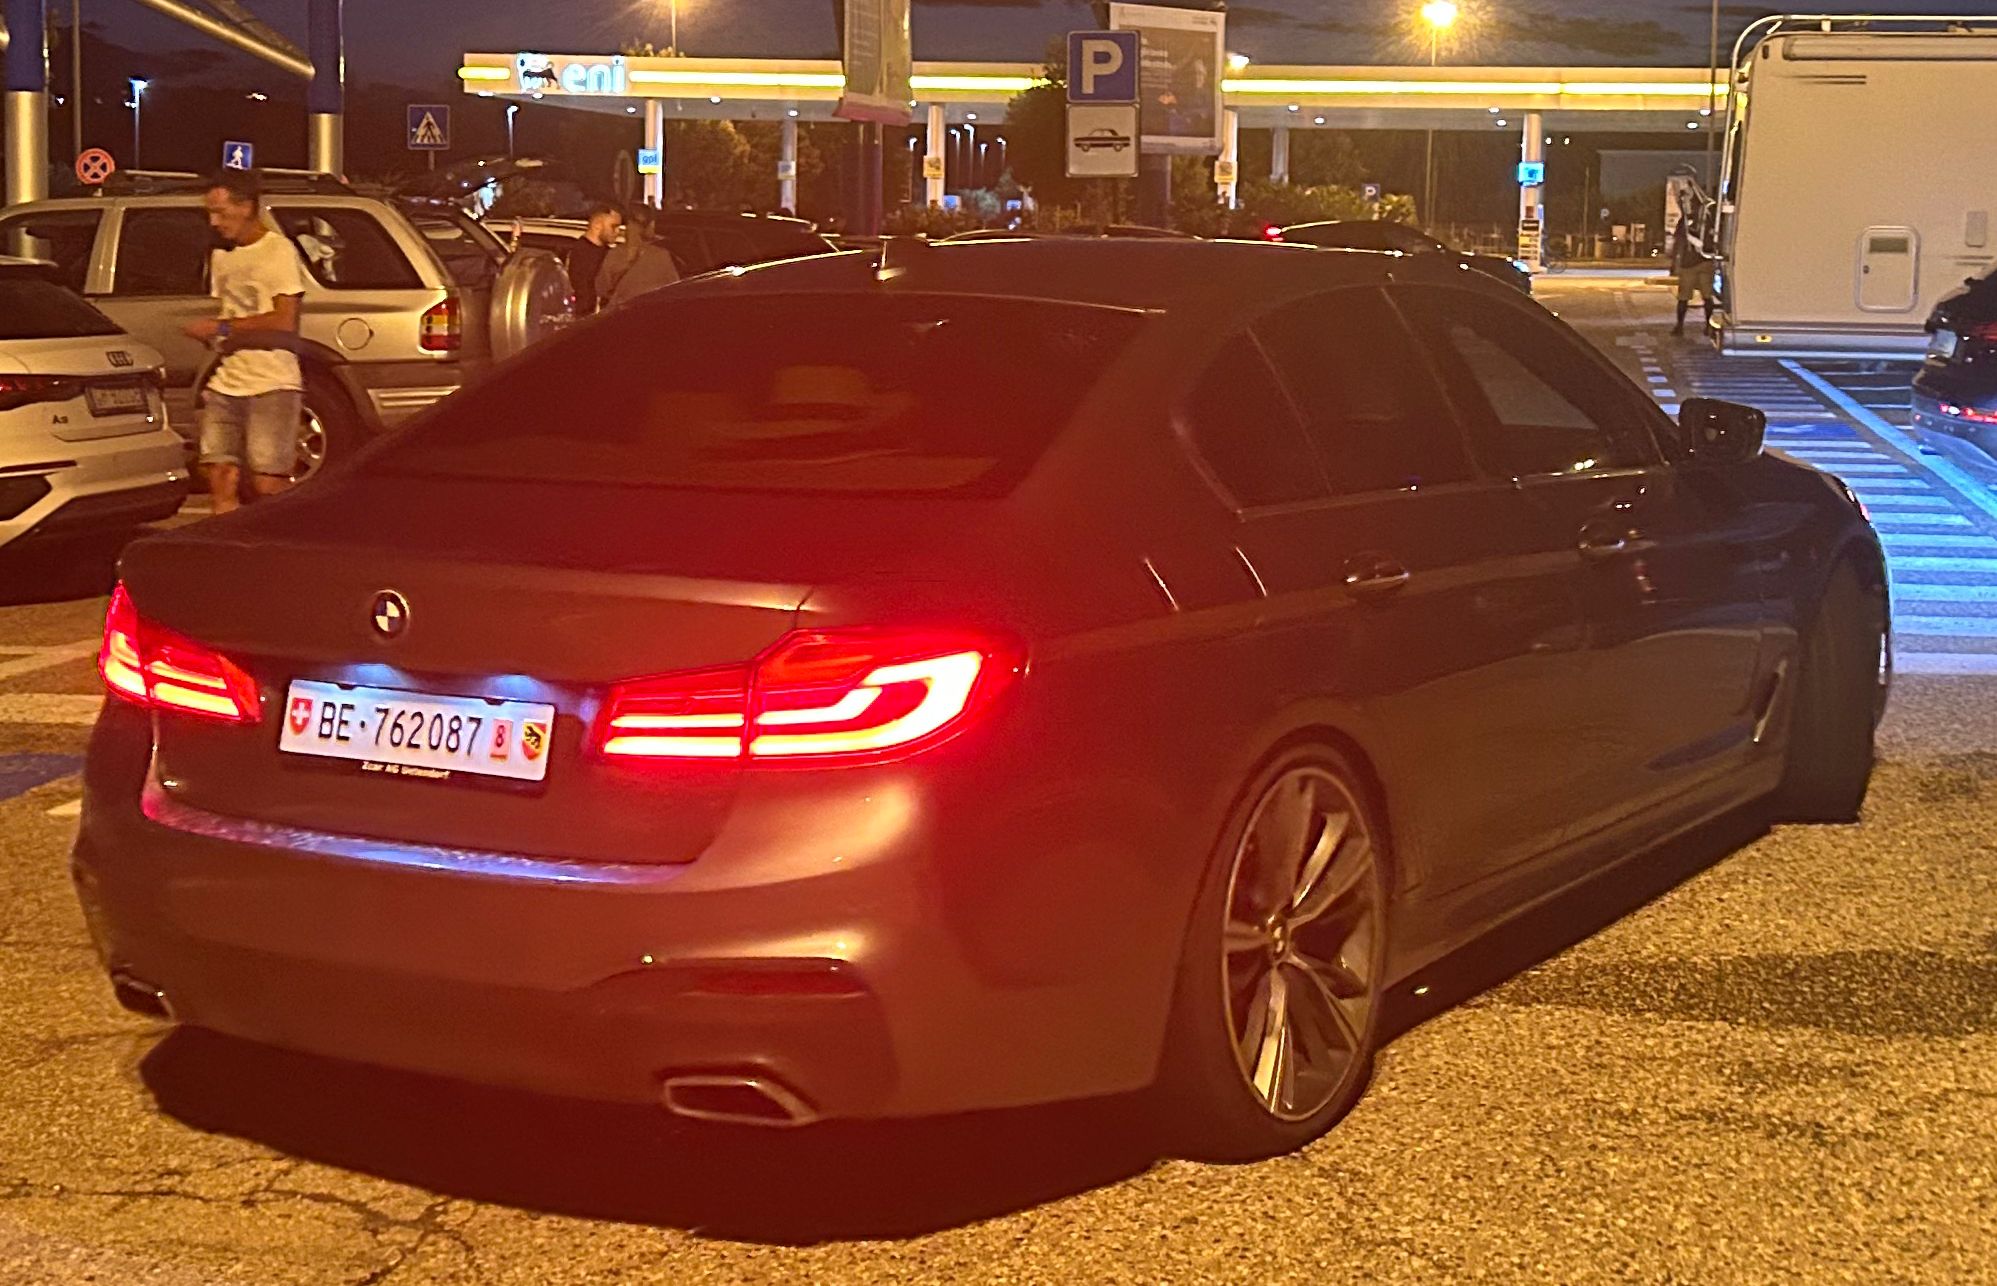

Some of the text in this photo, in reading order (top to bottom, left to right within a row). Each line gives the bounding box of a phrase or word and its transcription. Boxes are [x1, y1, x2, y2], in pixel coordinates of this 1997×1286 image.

[561, 55, 626, 93] eni
[1081, 39, 1123, 94] P
[1364, 185, 1377, 200] P
